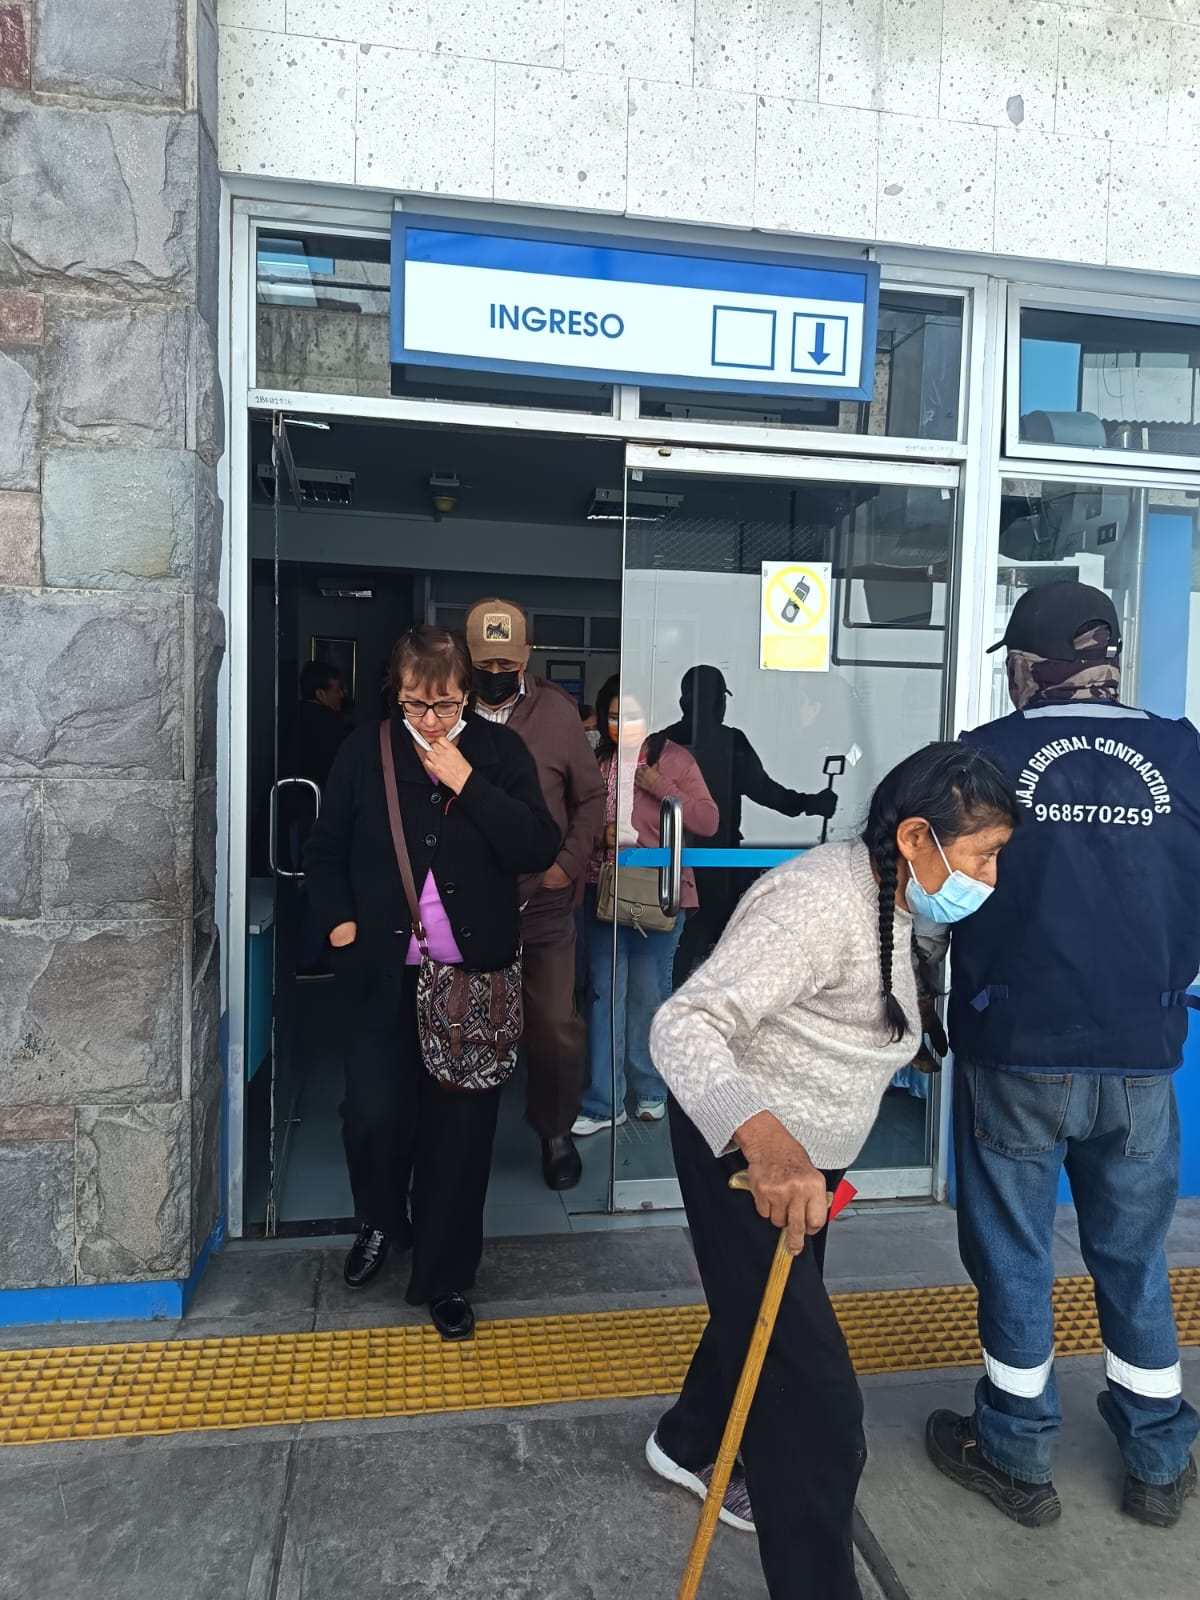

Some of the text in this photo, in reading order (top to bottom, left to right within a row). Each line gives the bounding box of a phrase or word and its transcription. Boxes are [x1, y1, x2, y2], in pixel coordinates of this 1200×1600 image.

[490, 303, 625, 339] INGRESO
[1015, 735, 1172, 814] JAJU GENERAL CONTRACTORS
[1034, 803, 1153, 826] 968570259
